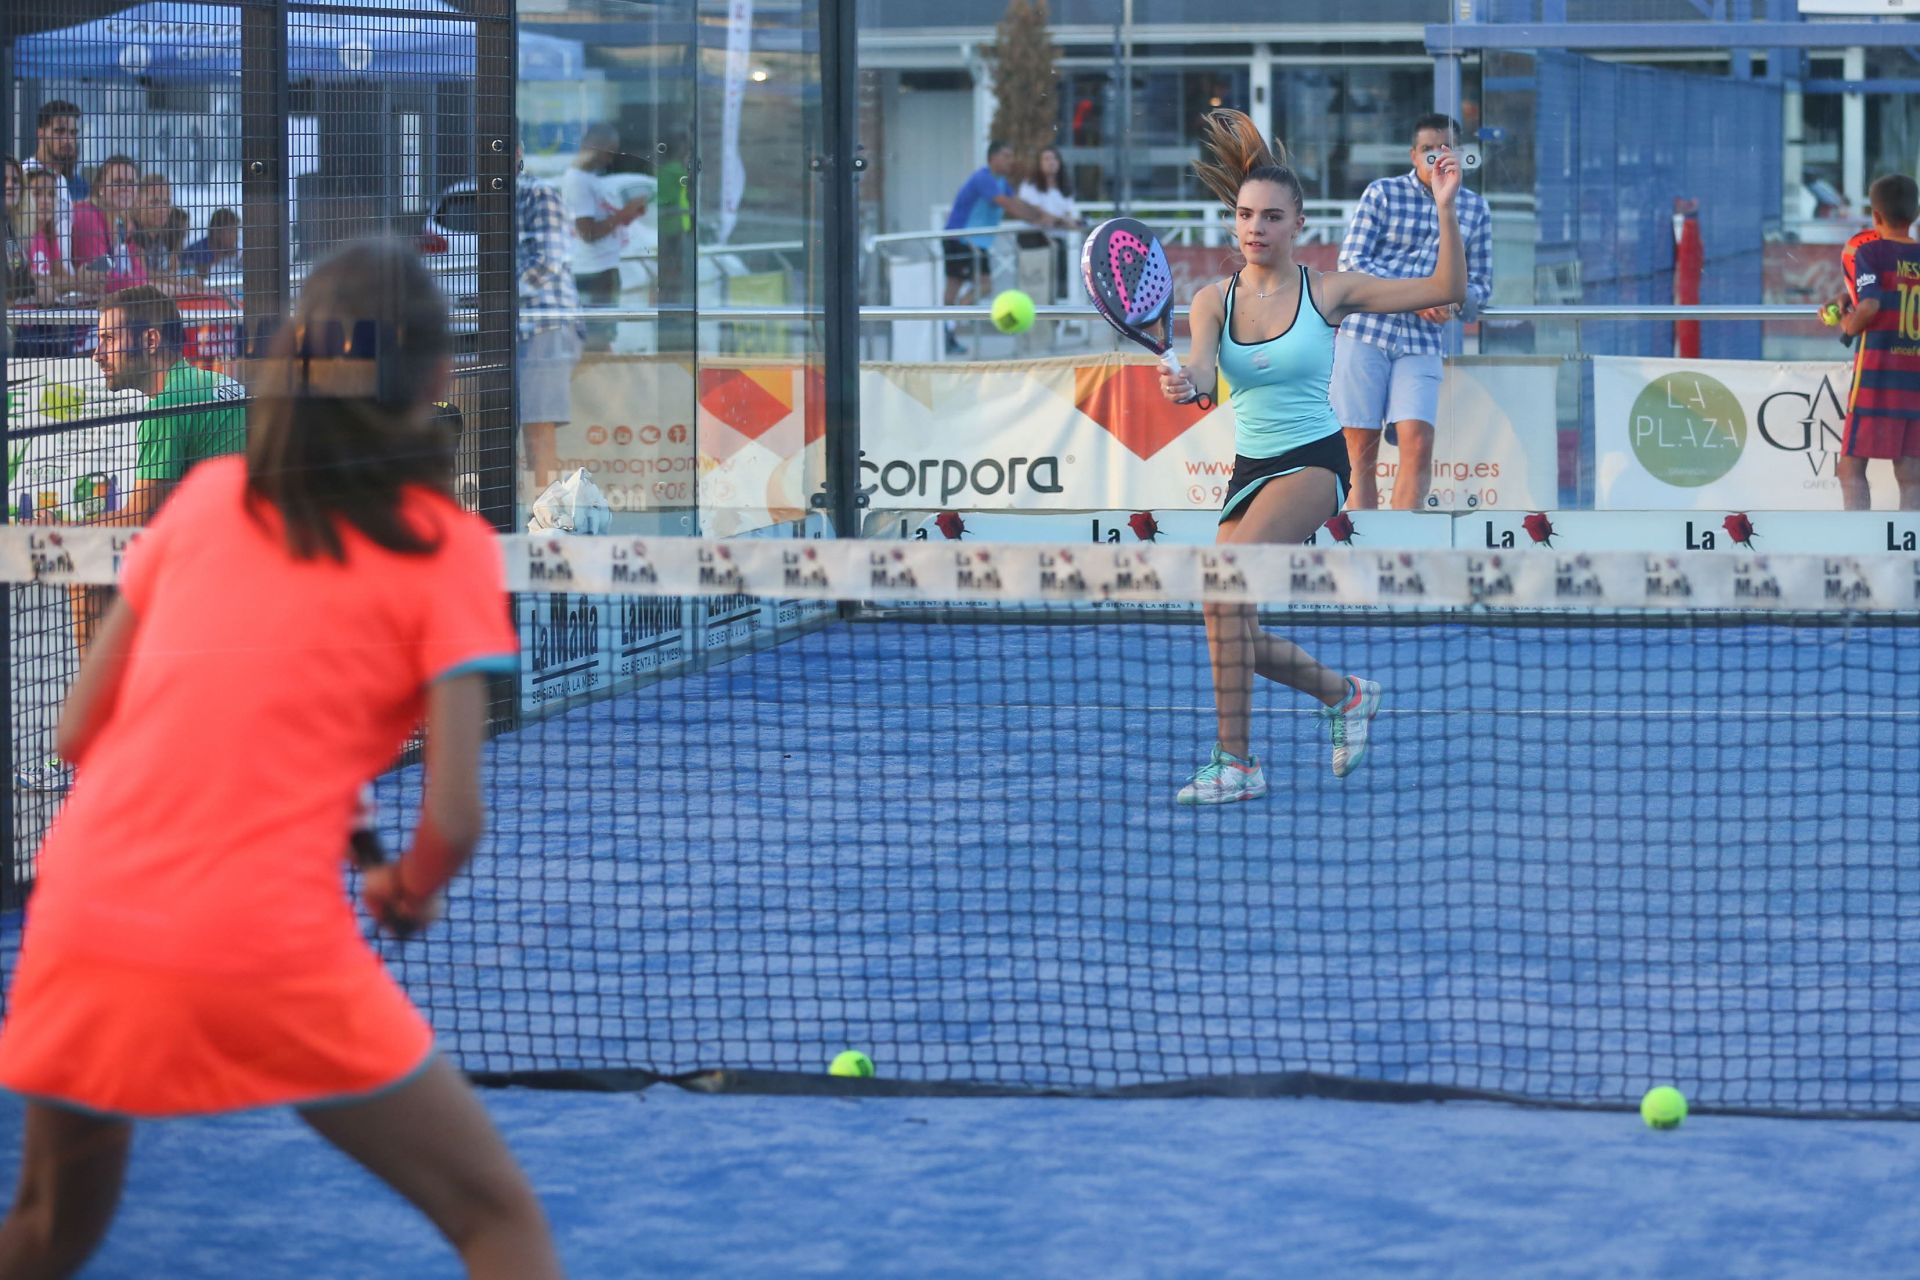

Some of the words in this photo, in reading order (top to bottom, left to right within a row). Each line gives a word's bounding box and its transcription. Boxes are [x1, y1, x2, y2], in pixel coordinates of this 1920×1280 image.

[1897, 260, 1920, 279] MES
[1636, 415, 1740, 449] PLAZA
[1092, 519, 1121, 544] La
[1486, 521, 1516, 549] La
[1686, 521, 1716, 551] La
[1887, 521, 1917, 551] La
